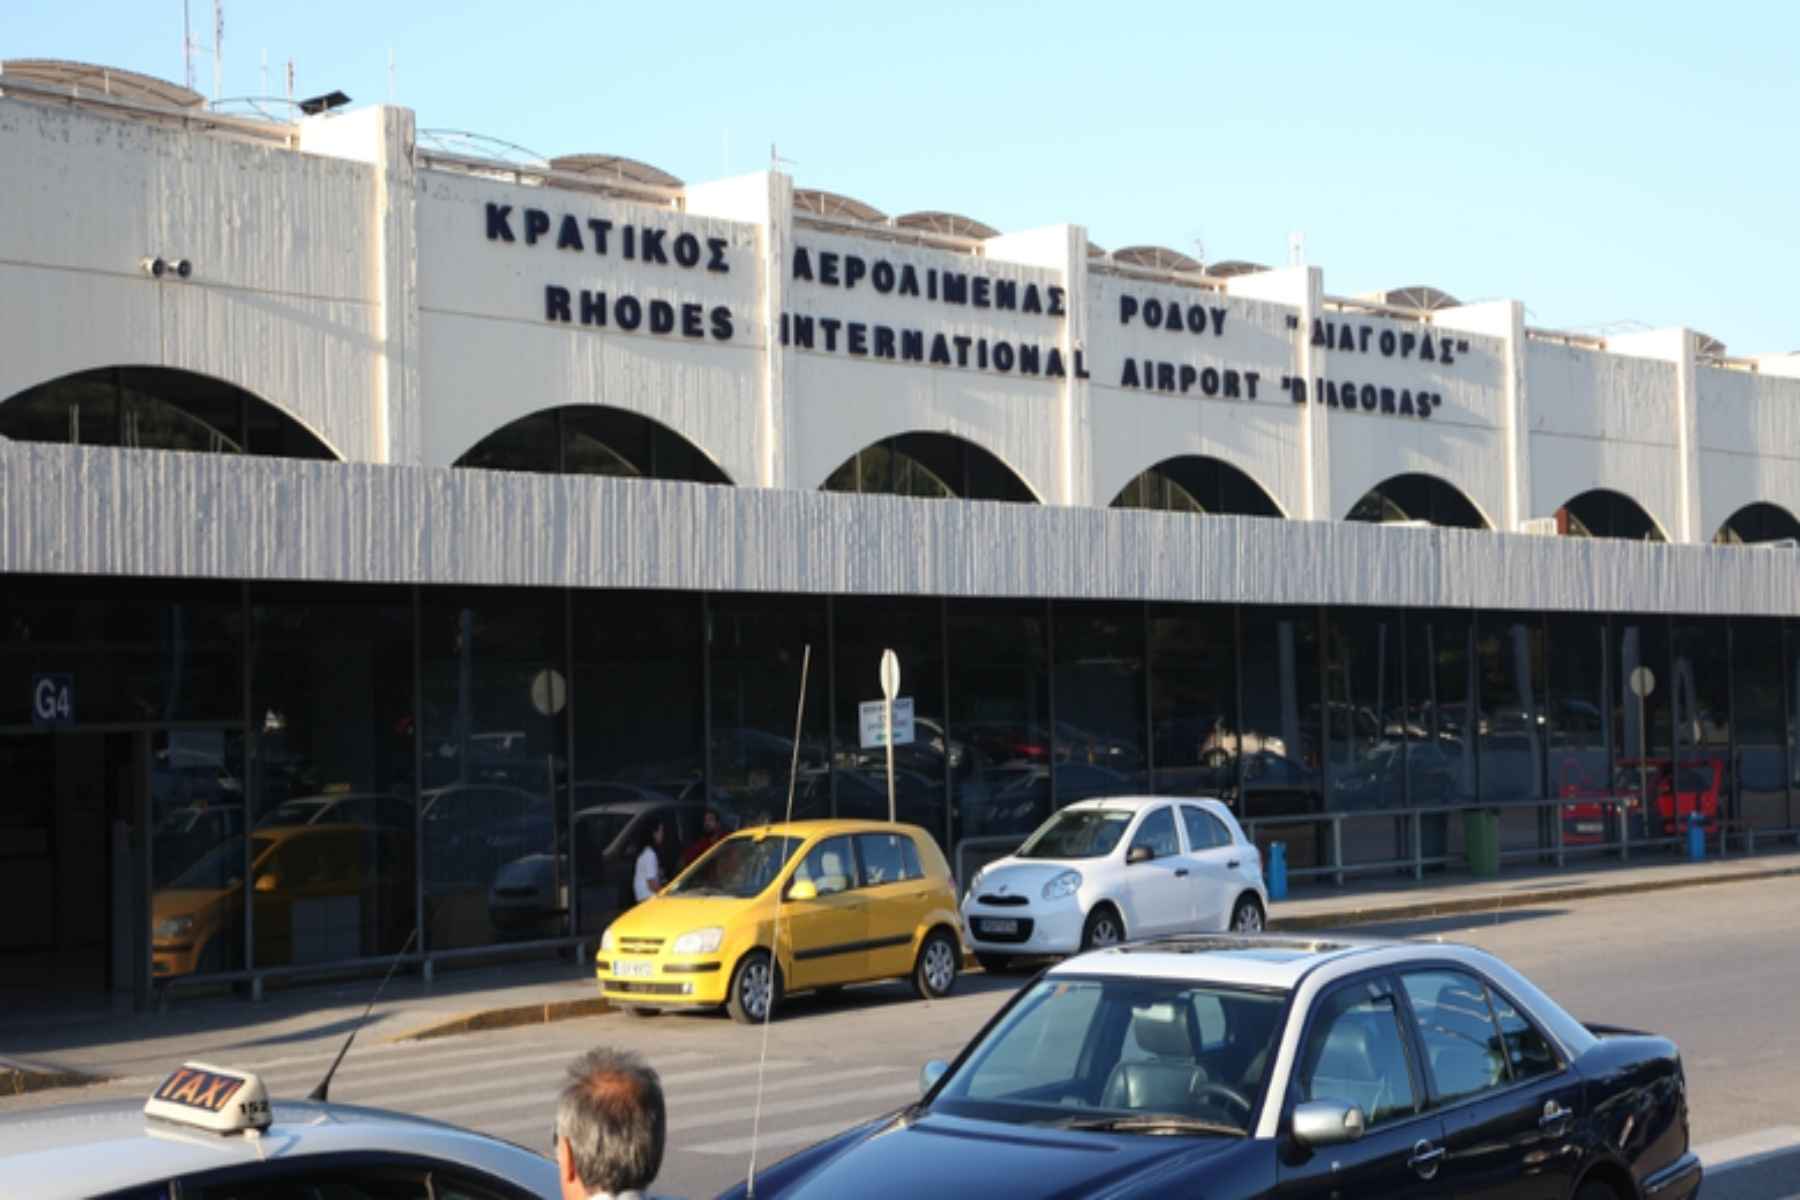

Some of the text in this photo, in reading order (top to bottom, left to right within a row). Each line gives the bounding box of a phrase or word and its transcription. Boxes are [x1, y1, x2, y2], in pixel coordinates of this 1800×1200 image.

[485, 202, 730, 273] ΚΡΑΤΙΚΟΣ
[793, 246, 1066, 316] ΑΕΡΟΛΙΜΕΝΑΣ
[1120, 295, 1228, 337] ΡΟΔΟΥ
[545, 285, 734, 341] RHODES
[780, 312, 1090, 379] INTERNATIONAL
[1120, 358, 1260, 400] AIRPORT
[36, 677, 70, 720] G4
[162, 1069, 242, 1112] TAXI
